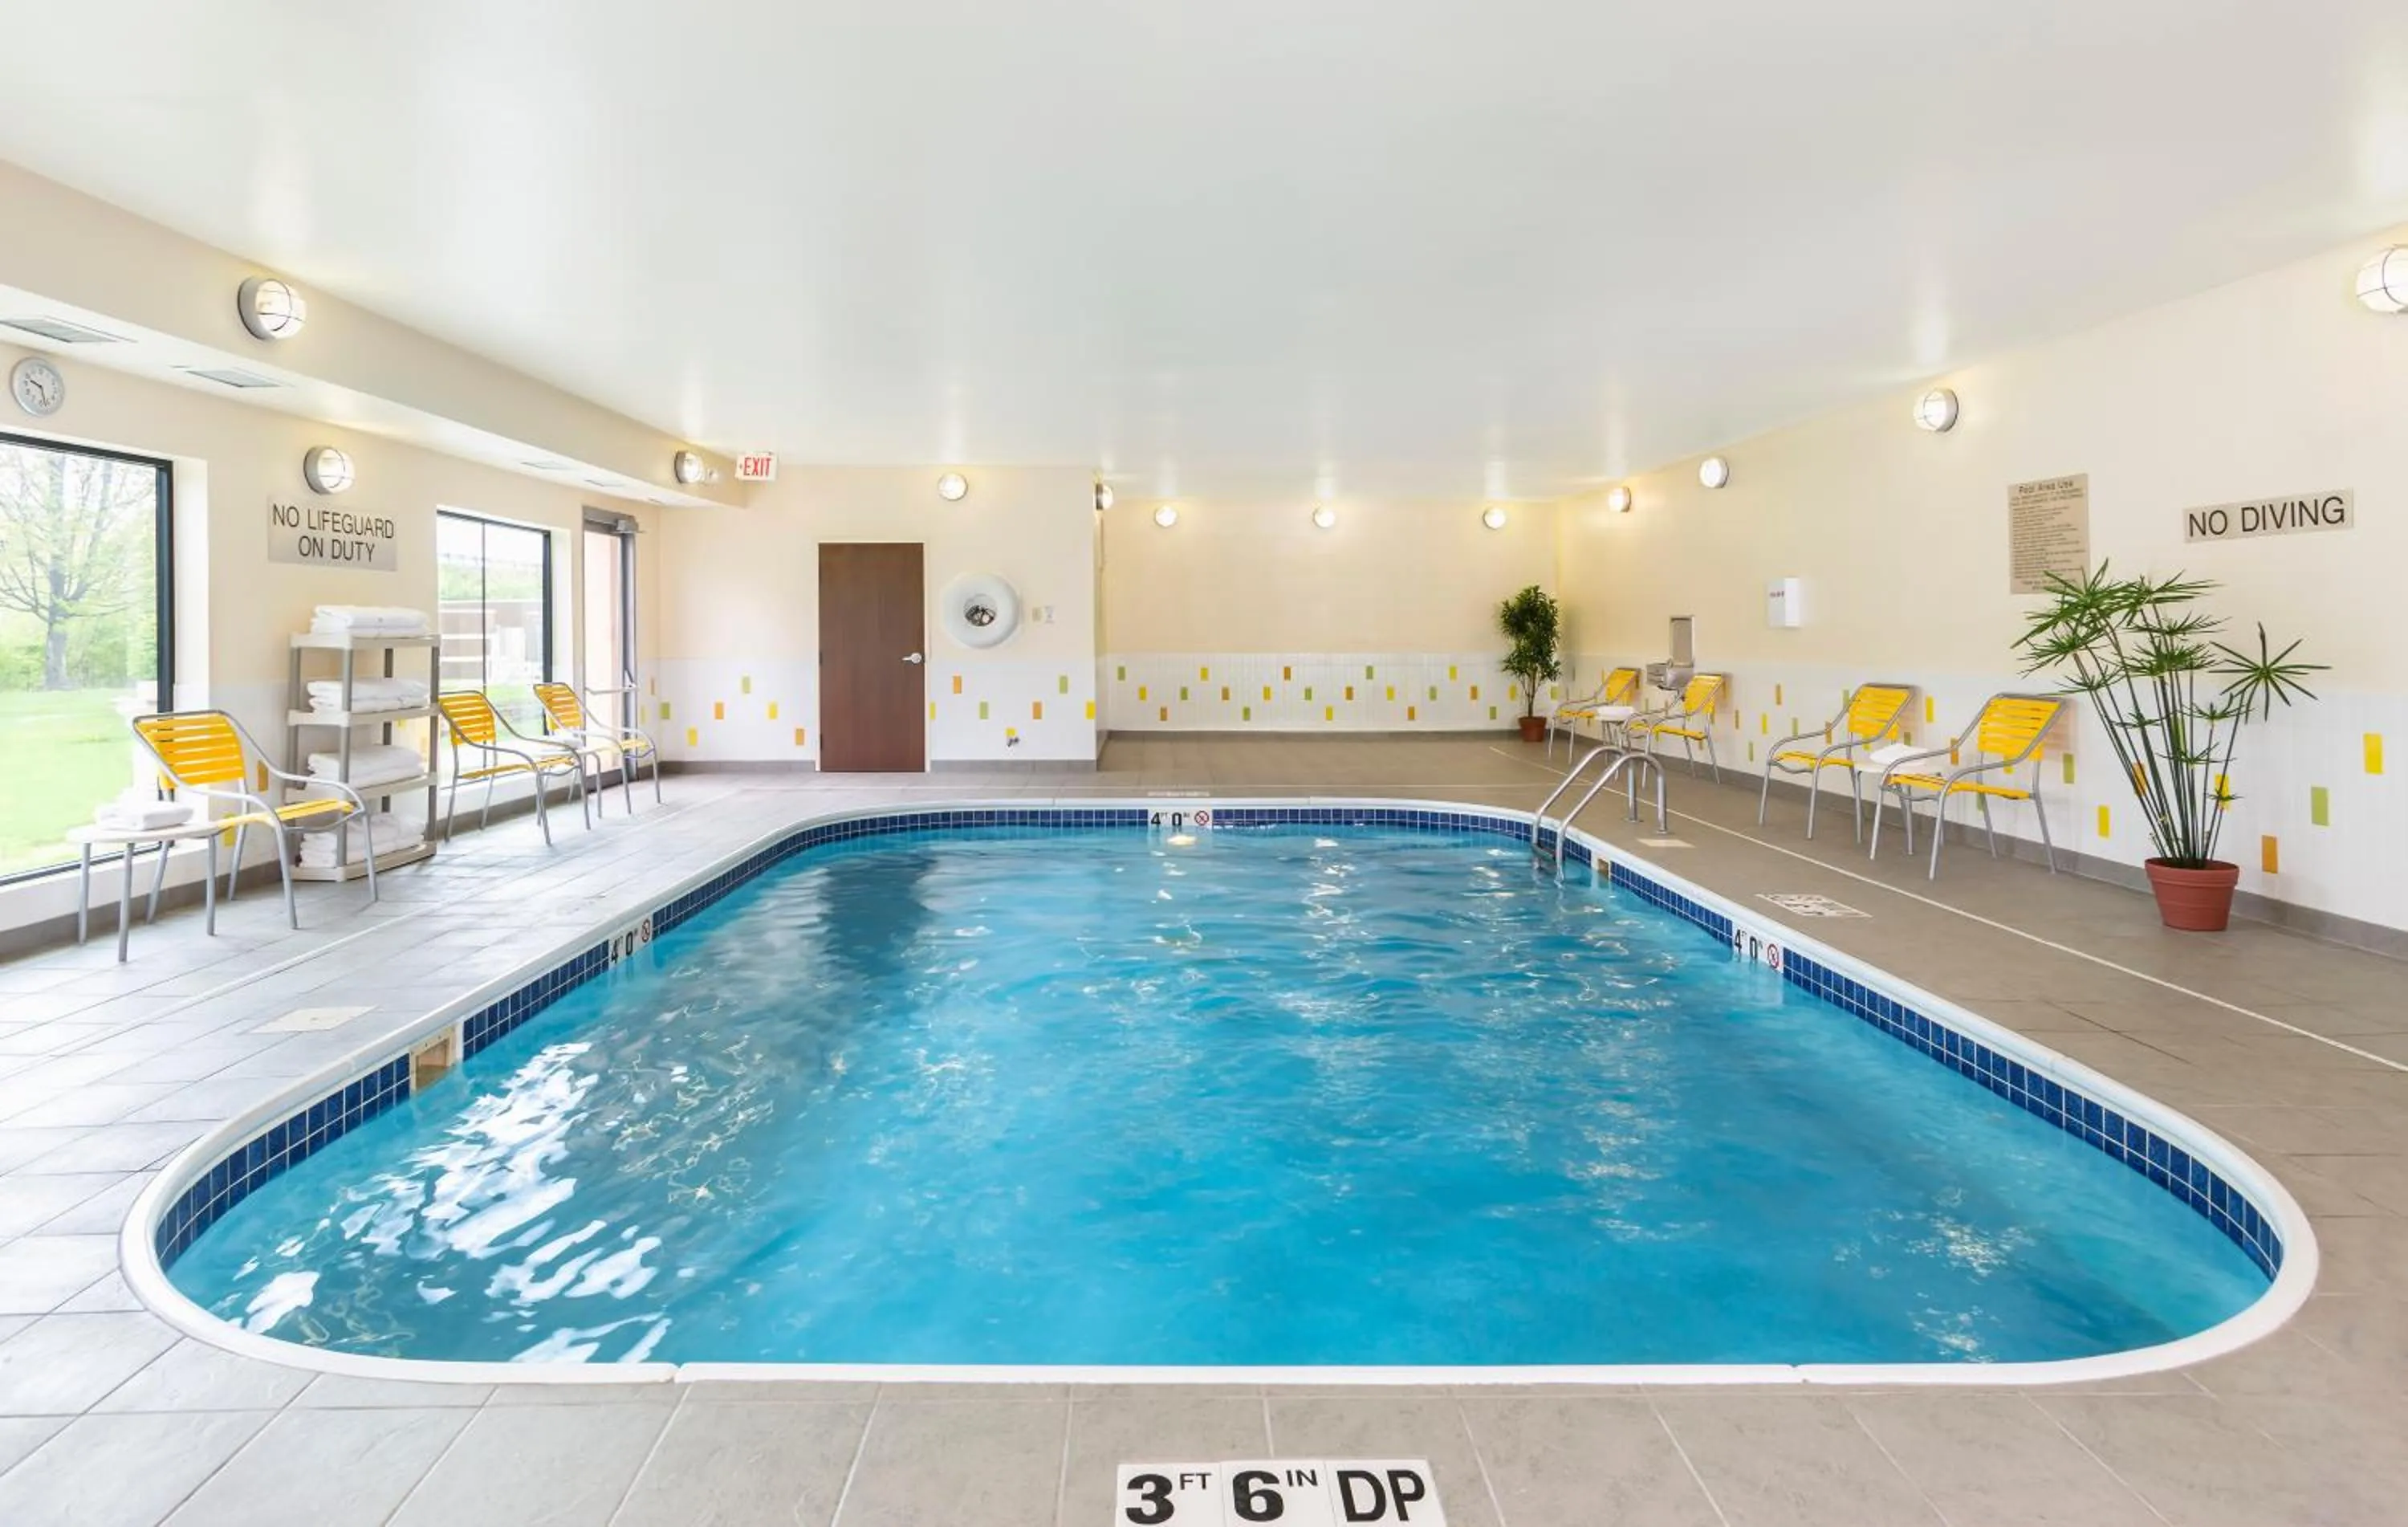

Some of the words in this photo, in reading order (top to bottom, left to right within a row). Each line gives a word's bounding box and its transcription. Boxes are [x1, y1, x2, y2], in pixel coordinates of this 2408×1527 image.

[743, 457, 771, 476] EXIT
[273, 503, 299, 527] NO
[307, 508, 394, 539] LIFEGUARD
[2189, 510, 2228, 537] NO
[2241, 495, 2345, 532] DIVING
[299, 535, 323, 558] ON
[332, 539, 375, 562] DUTY
[1150, 812, 1161, 825] 4
[1172, 812, 1182, 826] 0
[1735, 929, 1742, 953] 4
[1125, 1472, 1175, 1525] 3
[1179, 1472, 1212, 1491] FT
[1232, 1470, 1284, 1522] 6
[1286, 1468, 1318, 1488] IN
[1336, 1469, 1426, 1523] DP
